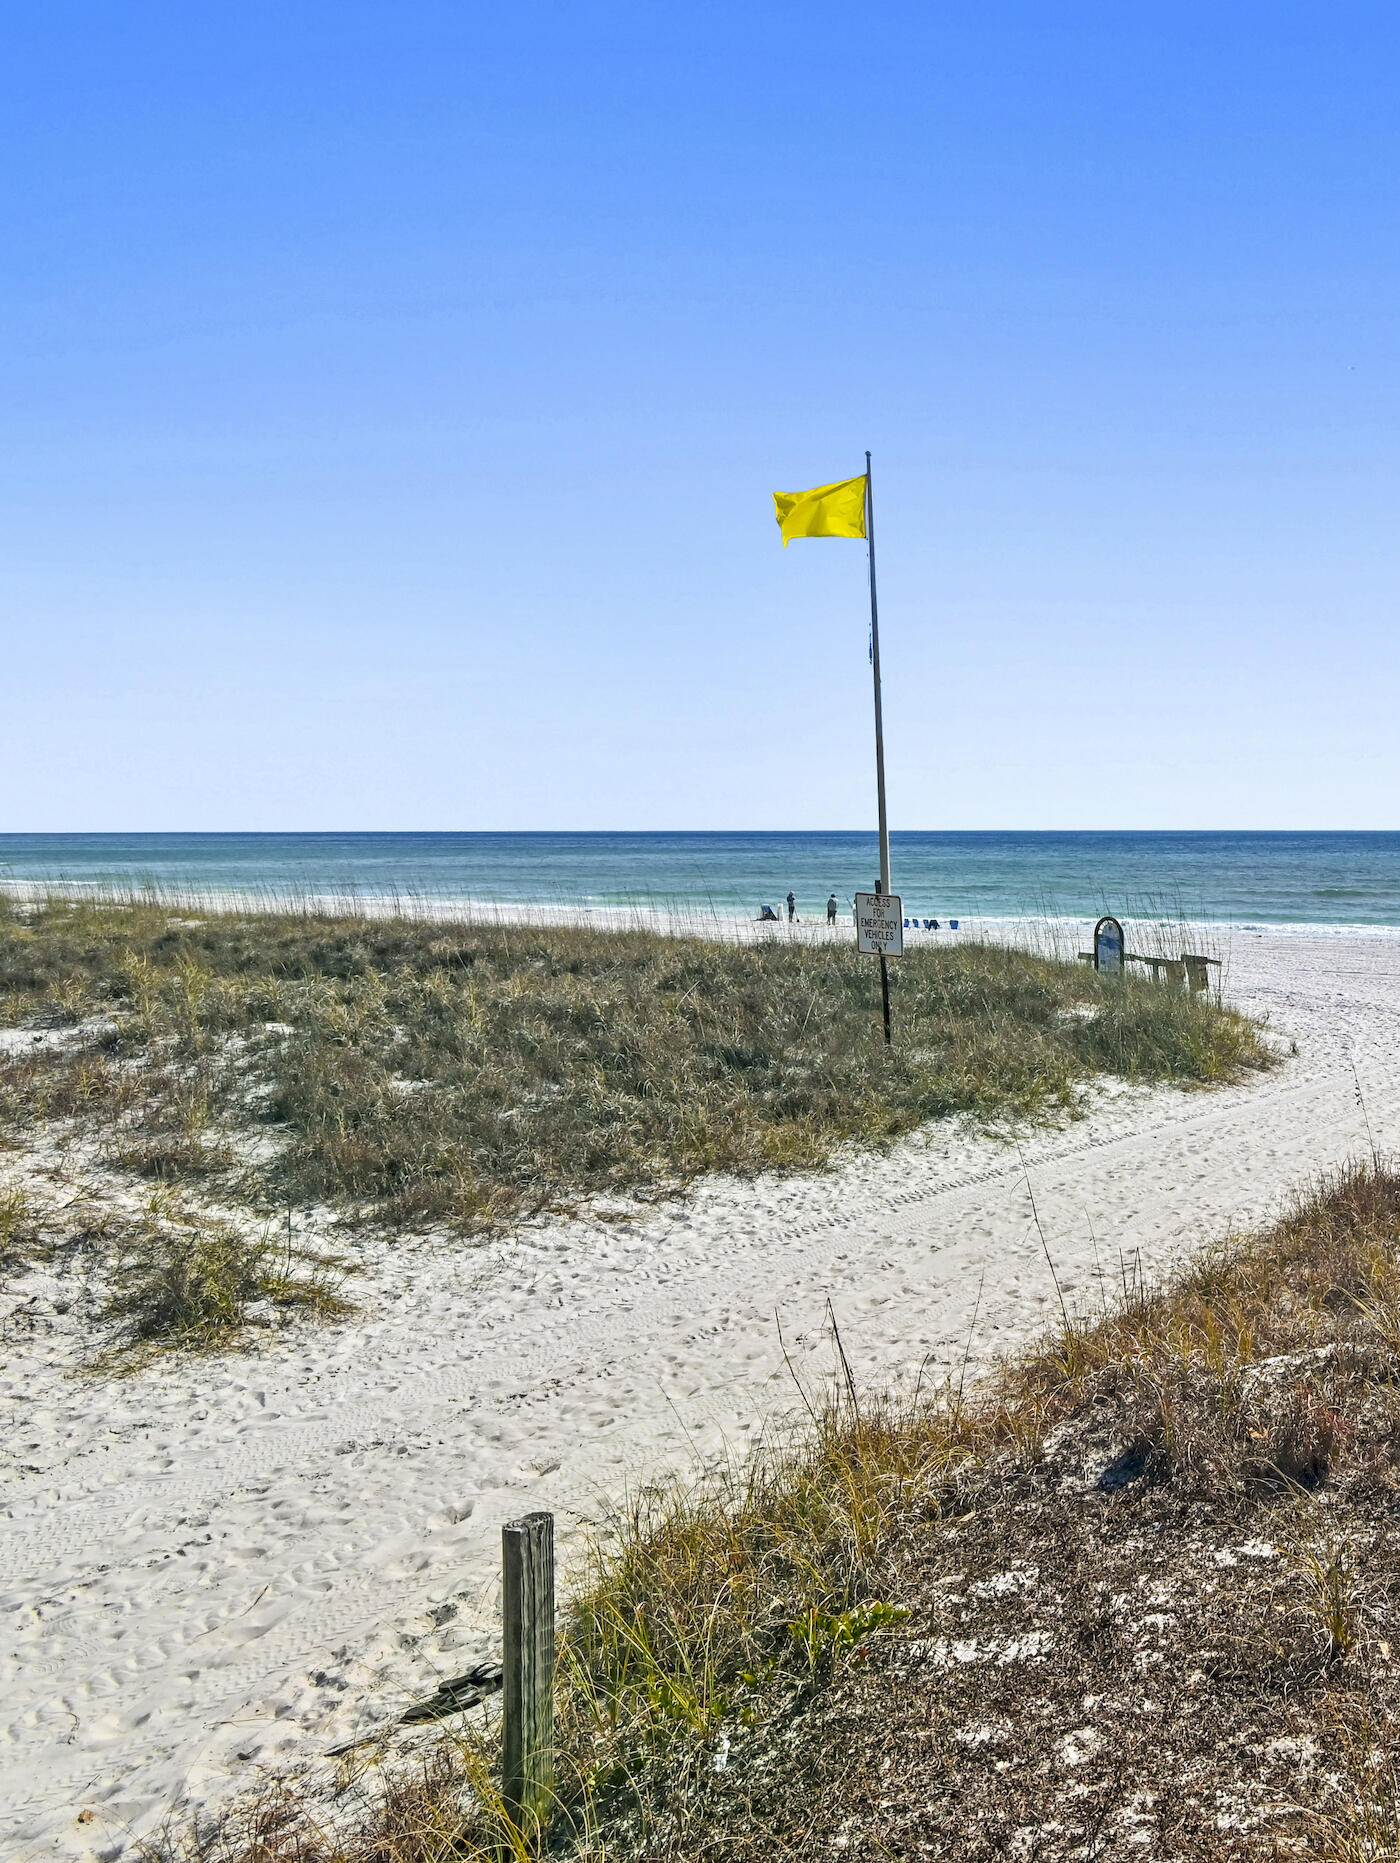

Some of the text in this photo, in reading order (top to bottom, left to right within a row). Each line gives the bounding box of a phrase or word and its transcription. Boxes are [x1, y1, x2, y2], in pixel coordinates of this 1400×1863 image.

[867, 897, 890, 907] ACCESS
[873, 909, 885, 918] FOR
[861, 917, 897, 930] EMERGENCY
[864, 929, 894, 940] VEHICLES
